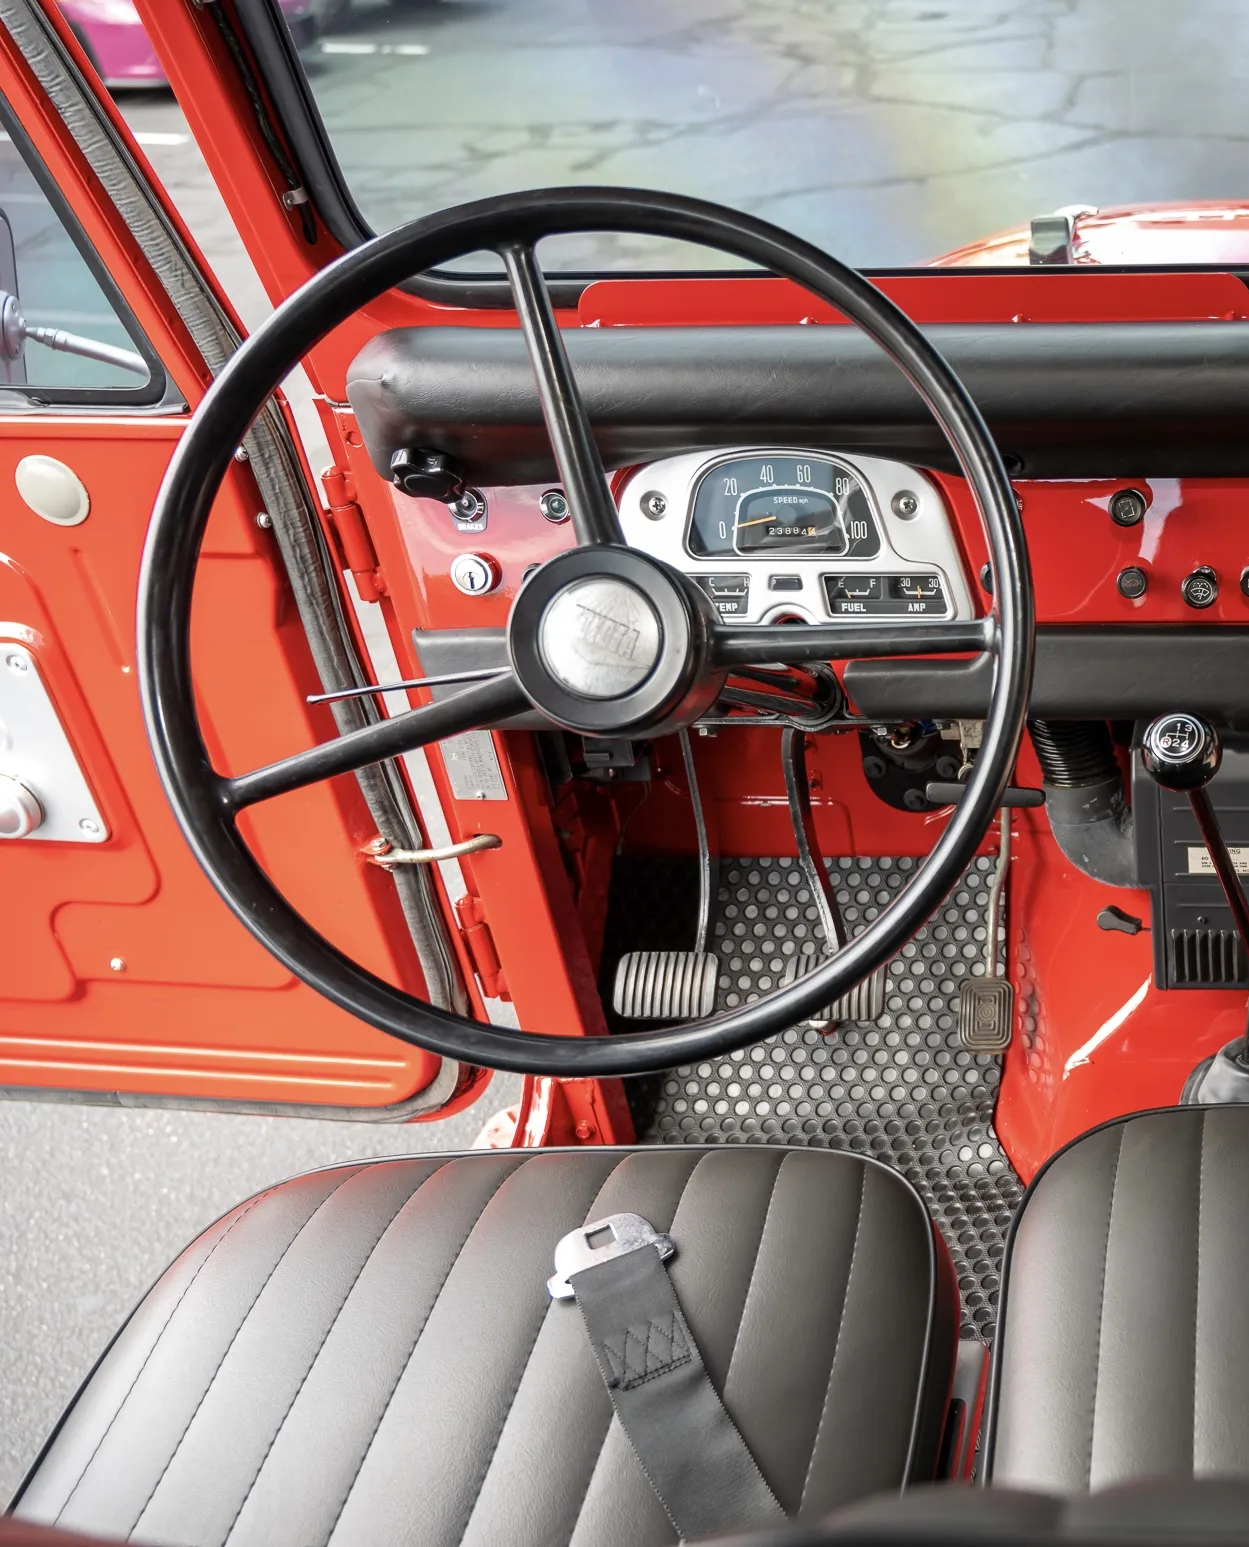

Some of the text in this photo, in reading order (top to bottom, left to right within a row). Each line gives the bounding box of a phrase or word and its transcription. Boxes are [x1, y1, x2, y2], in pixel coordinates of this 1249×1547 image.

[760, 465, 774, 483] 40
[797, 465, 811, 483] 60
[724, 478, 738, 496] 20
[835, 478, 850, 496] 80
[718, 521, 727, 539] 0
[850, 521, 868, 539] 100
[708, 577, 715, 587] C
[743, 577, 750, 587] H
[869, 579, 876, 588] F
[714, 602, 738, 612] TEMP
[841, 602, 867, 612] FUEL
[907, 602, 926, 612] AMP
[1184, 724, 1193, 732] 3
[1172, 739, 1180, 747] 2
[1181, 740, 1189, 748] 4
